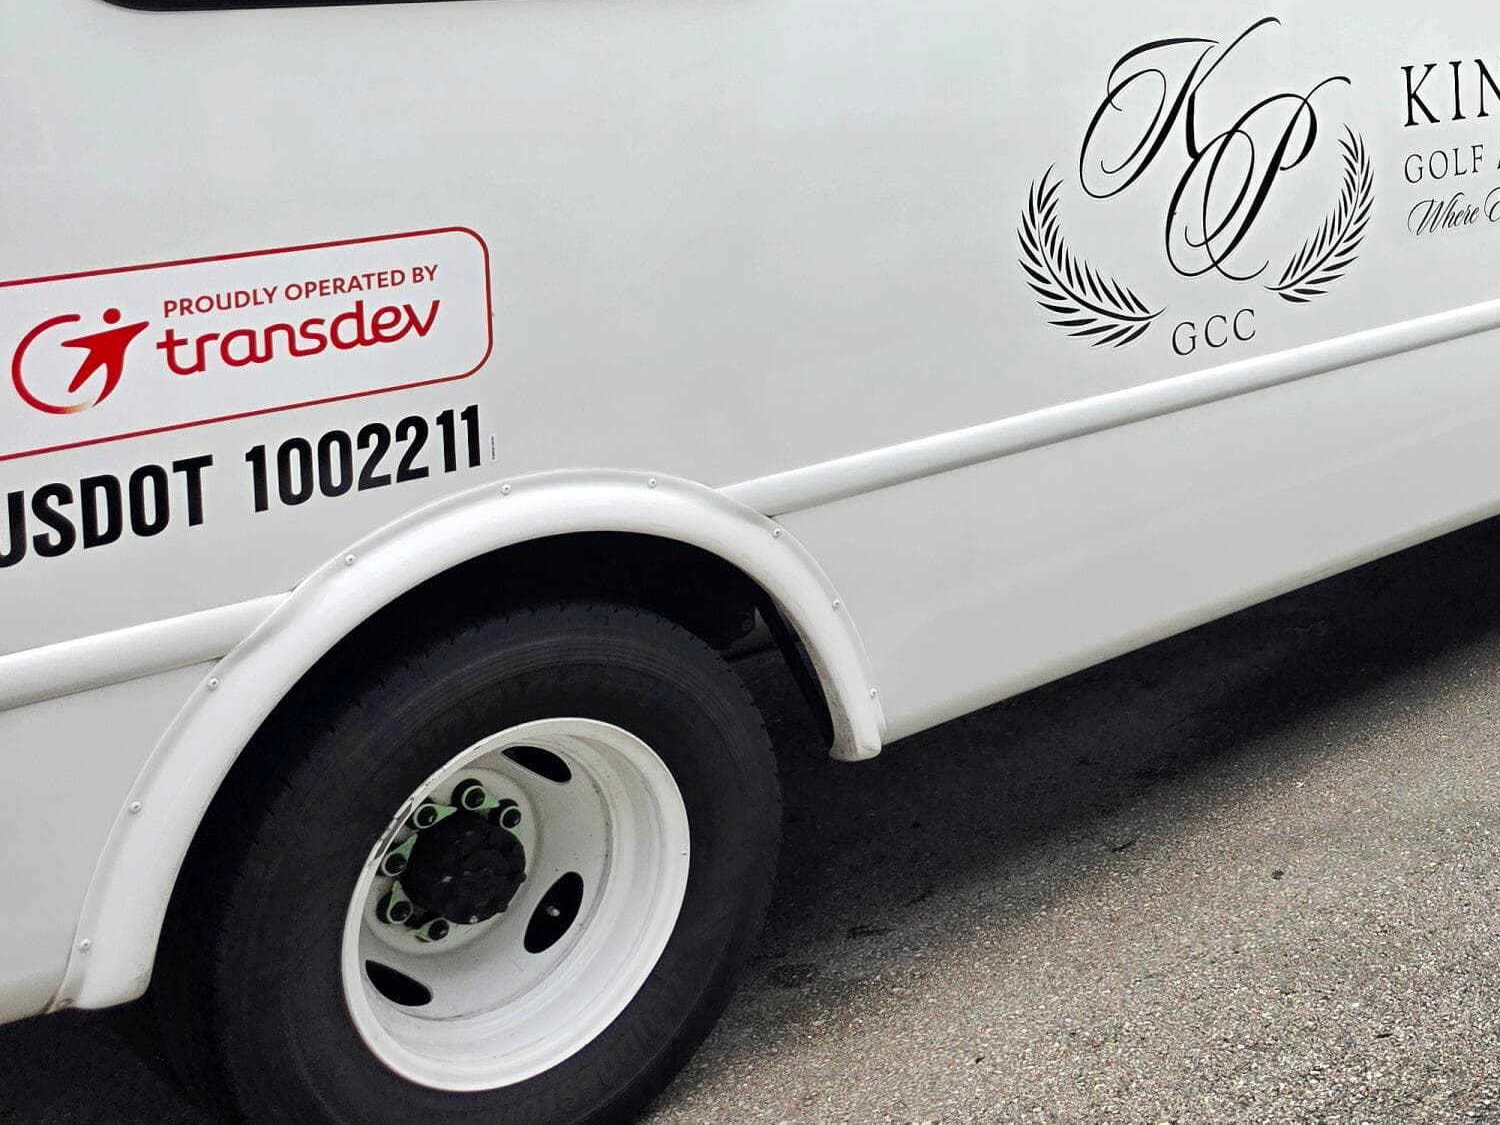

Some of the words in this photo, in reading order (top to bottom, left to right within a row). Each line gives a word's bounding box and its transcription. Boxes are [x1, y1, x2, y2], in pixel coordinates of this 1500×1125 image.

[1404, 144, 1484, 184] GOLF
[1408, 192, 1481, 235] Where
[163, 286, 278, 318] PROUDLY
[284, 269, 406, 301] OPERATED
[411, 264, 438, 284] BY
[156, 299, 440, 375] transdev
[1172, 308, 1256, 356] GCC
[0, 454, 213, 568] USDOT
[245, 405, 481, 513] 1002211
